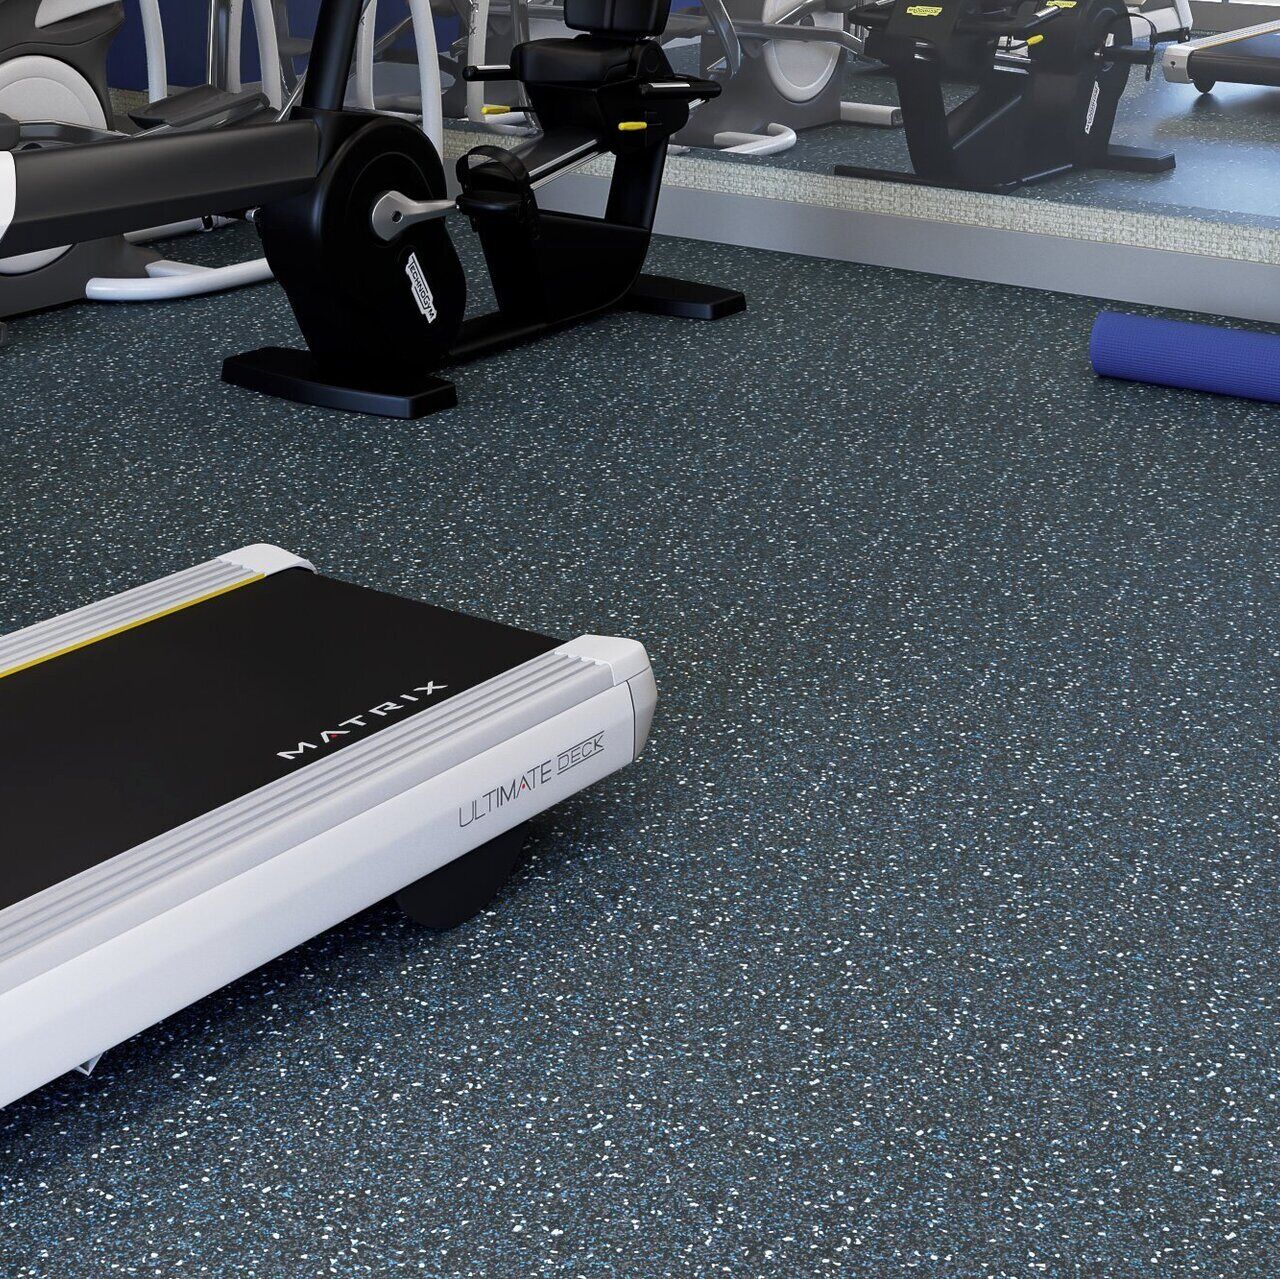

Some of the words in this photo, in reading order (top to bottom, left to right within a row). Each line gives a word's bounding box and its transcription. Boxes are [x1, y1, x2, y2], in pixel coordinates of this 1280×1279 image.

[407, 258, 435, 319] TECHNOGYM
[276, 680, 449, 760] MATRIX
[459, 760, 552, 828] ULTIMATE
[557, 732, 605, 774] DECK
